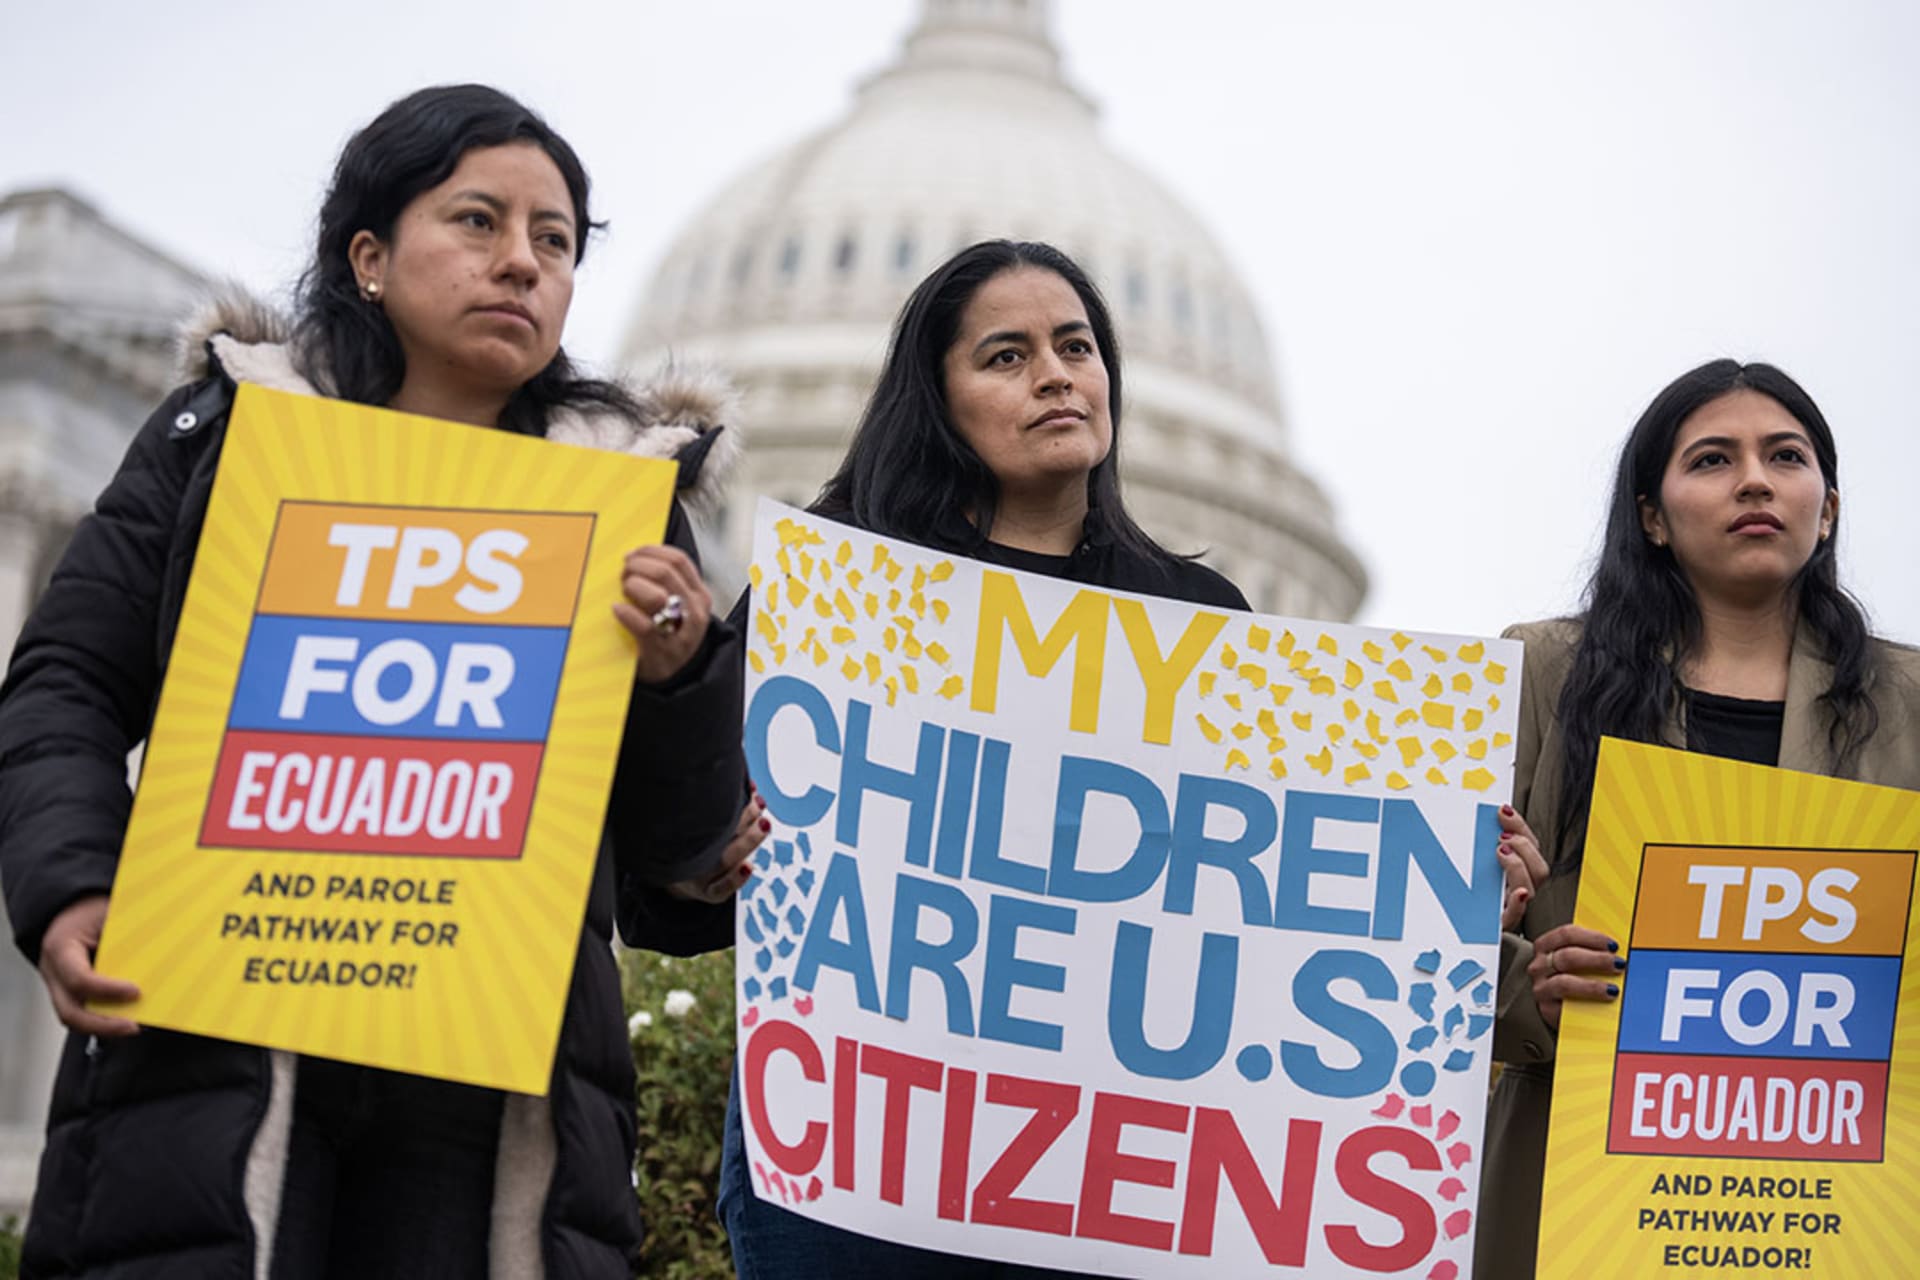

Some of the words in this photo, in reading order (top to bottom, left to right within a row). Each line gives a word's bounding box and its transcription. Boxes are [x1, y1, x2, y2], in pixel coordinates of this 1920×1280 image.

[327, 523, 530, 614] TPS
[278, 635, 516, 729] FOR
[970, 569, 1231, 745] MY
[227, 751, 514, 840] ECUADOR
[744, 675, 1504, 945] CHILDREN
[243, 872, 316, 899] AND
[325, 876, 458, 905] PAROLE
[1688, 865, 1861, 944] TPS
[221, 915, 384, 946] PATHWAY
[391, 920, 460, 948] FOR
[792, 852, 1077, 1052] ARE
[242, 958, 418, 989] ECUADOR!
[1660, 968, 1857, 1049] FOR
[743, 1018, 1444, 1275] CITIZENS
[1630, 1072, 1865, 1146] ECUADOR
[1638, 1209, 1775, 1234] PATHWAY
[1783, 1213, 1842, 1235] FOR
[1651, 1174, 1712, 1196] AND
[1721, 1177, 1833, 1199] PAROLE
[1663, 1246, 1812, 1269] ECUADOR!
